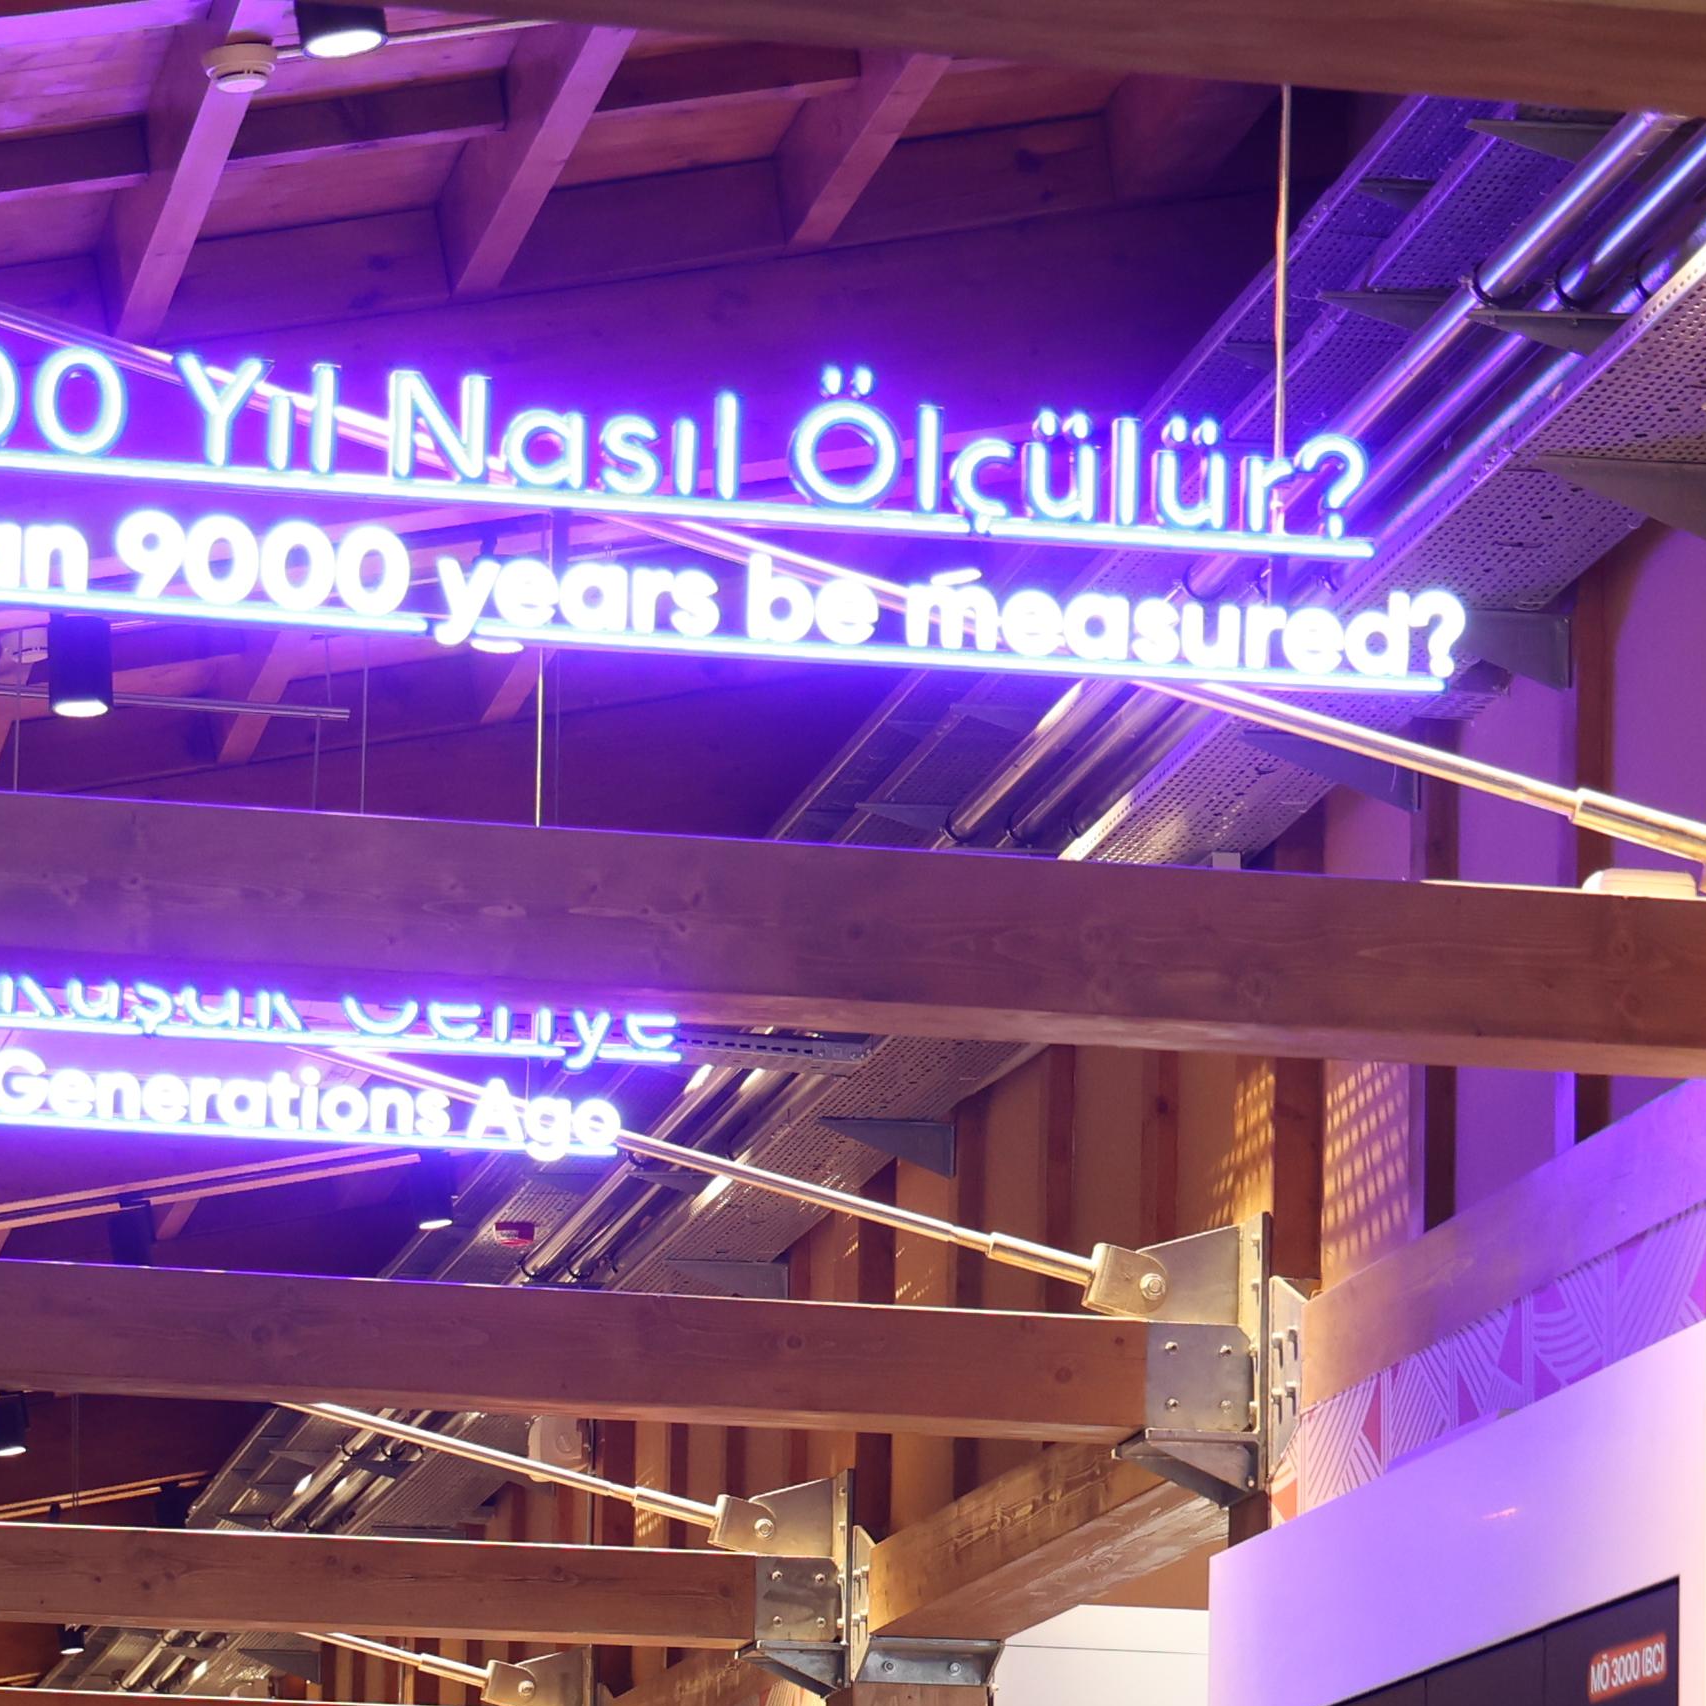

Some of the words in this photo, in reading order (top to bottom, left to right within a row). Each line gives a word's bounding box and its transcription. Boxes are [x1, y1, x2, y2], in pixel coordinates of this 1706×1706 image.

[172, 353, 338, 474] Yıl
[387, 369, 739, 500] Nasıl
[787, 363, 1369, 539] Ölçülür?
[114, 508, 411, 616] 9000
[435, 555, 720, 647] years
[745, 553, 880, 646] be
[905, 583, 1466, 678] measured?
[466, 1077, 622, 1162] Ago
[1590, 1653, 1609, 1694] MÖ
[1611, 1650, 1640, 1687] 3000
[1642, 1642, 1665, 1677] (BC)
